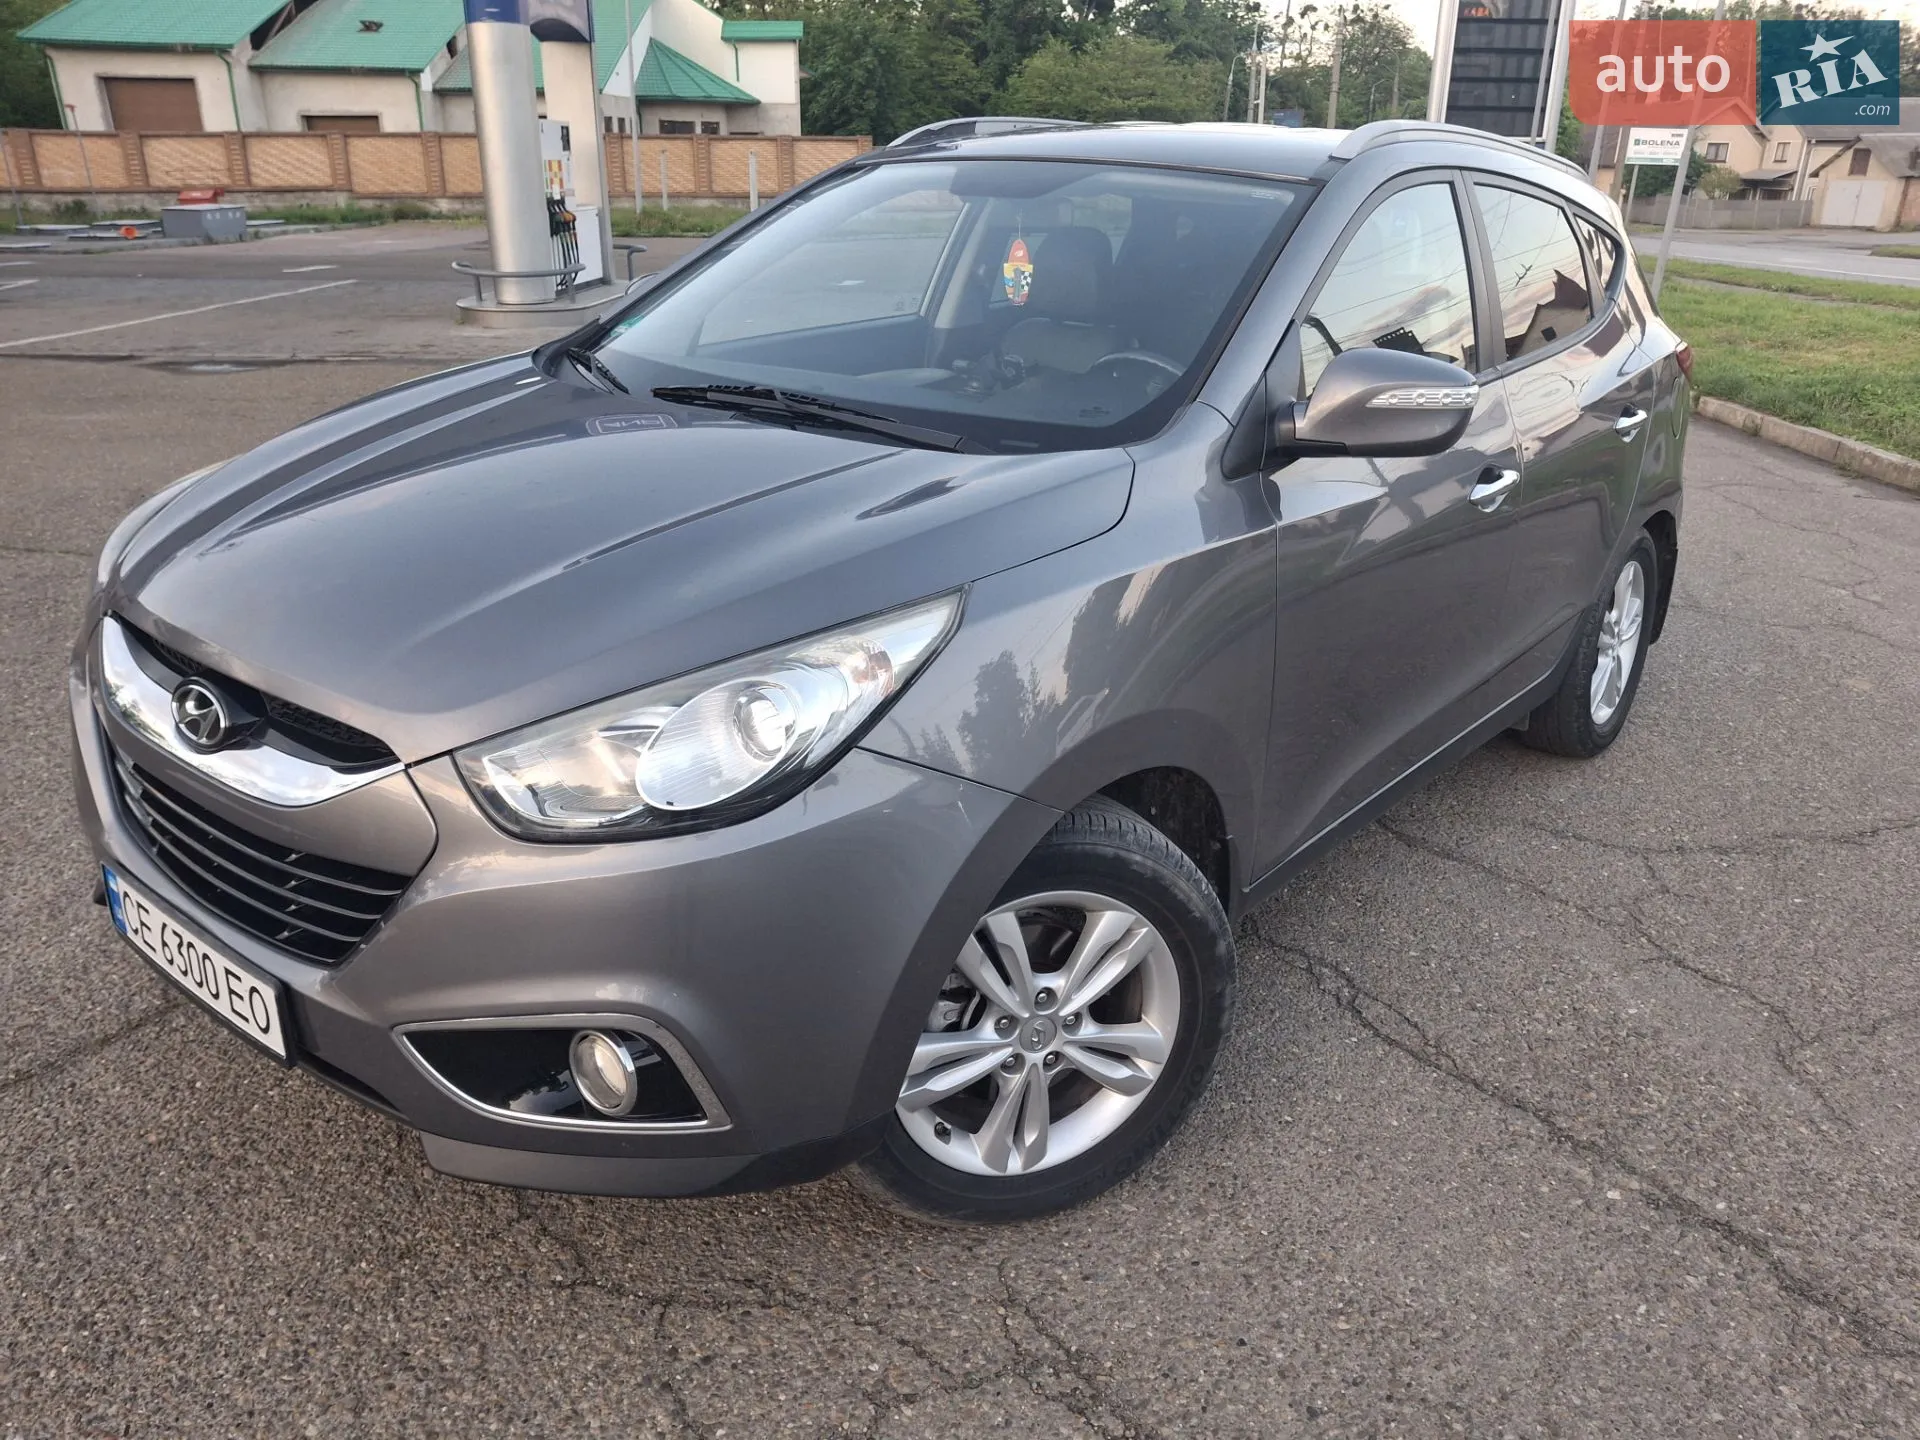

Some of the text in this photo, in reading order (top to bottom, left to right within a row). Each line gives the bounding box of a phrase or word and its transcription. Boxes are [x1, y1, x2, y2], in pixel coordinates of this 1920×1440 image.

[123, 891, 270, 1035] CE 6300 EO
